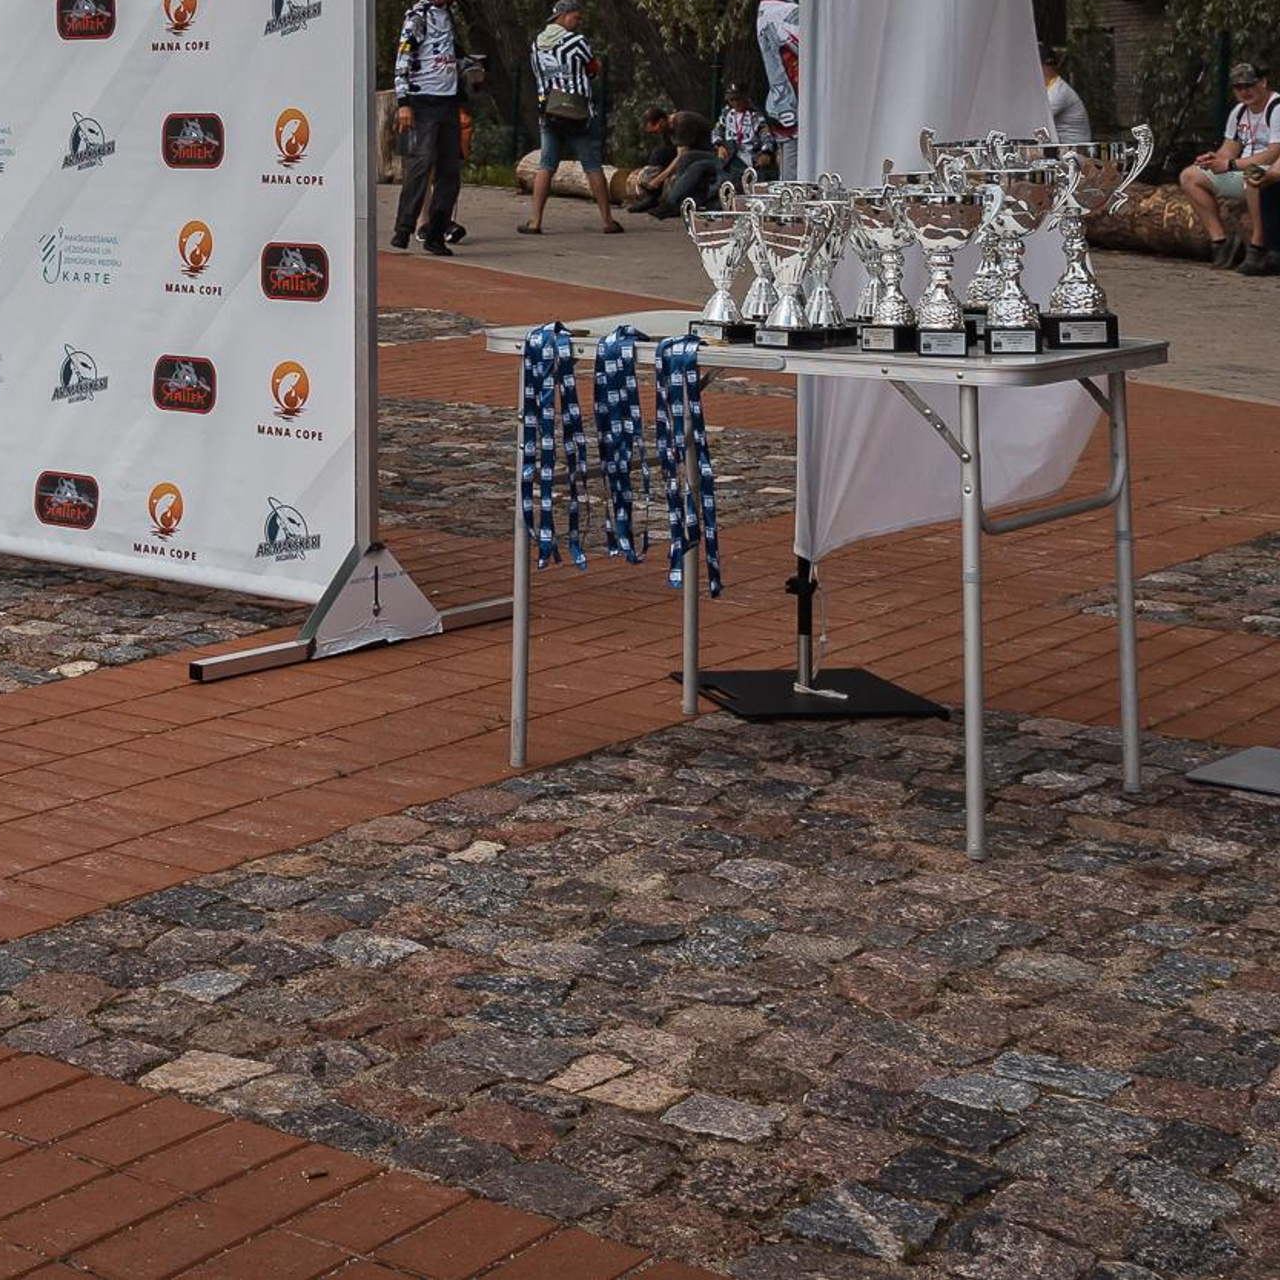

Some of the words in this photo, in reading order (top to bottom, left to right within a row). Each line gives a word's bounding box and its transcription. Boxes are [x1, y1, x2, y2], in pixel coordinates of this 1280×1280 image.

[151, 42, 181, 52] MANA
[185, 40, 210, 51] COPE
[262, 174, 291, 184] MANA
[296, 175, 324, 185] COPE
[62, 270, 111, 284] KARTE
[165, 283, 195, 294] MANA
[199, 285, 222, 296] COPE
[257, 424, 291, 438] MANA
[295, 429, 323, 441] COPE
[133, 543, 165, 556] MANA
[170, 548, 197, 561] COPE
